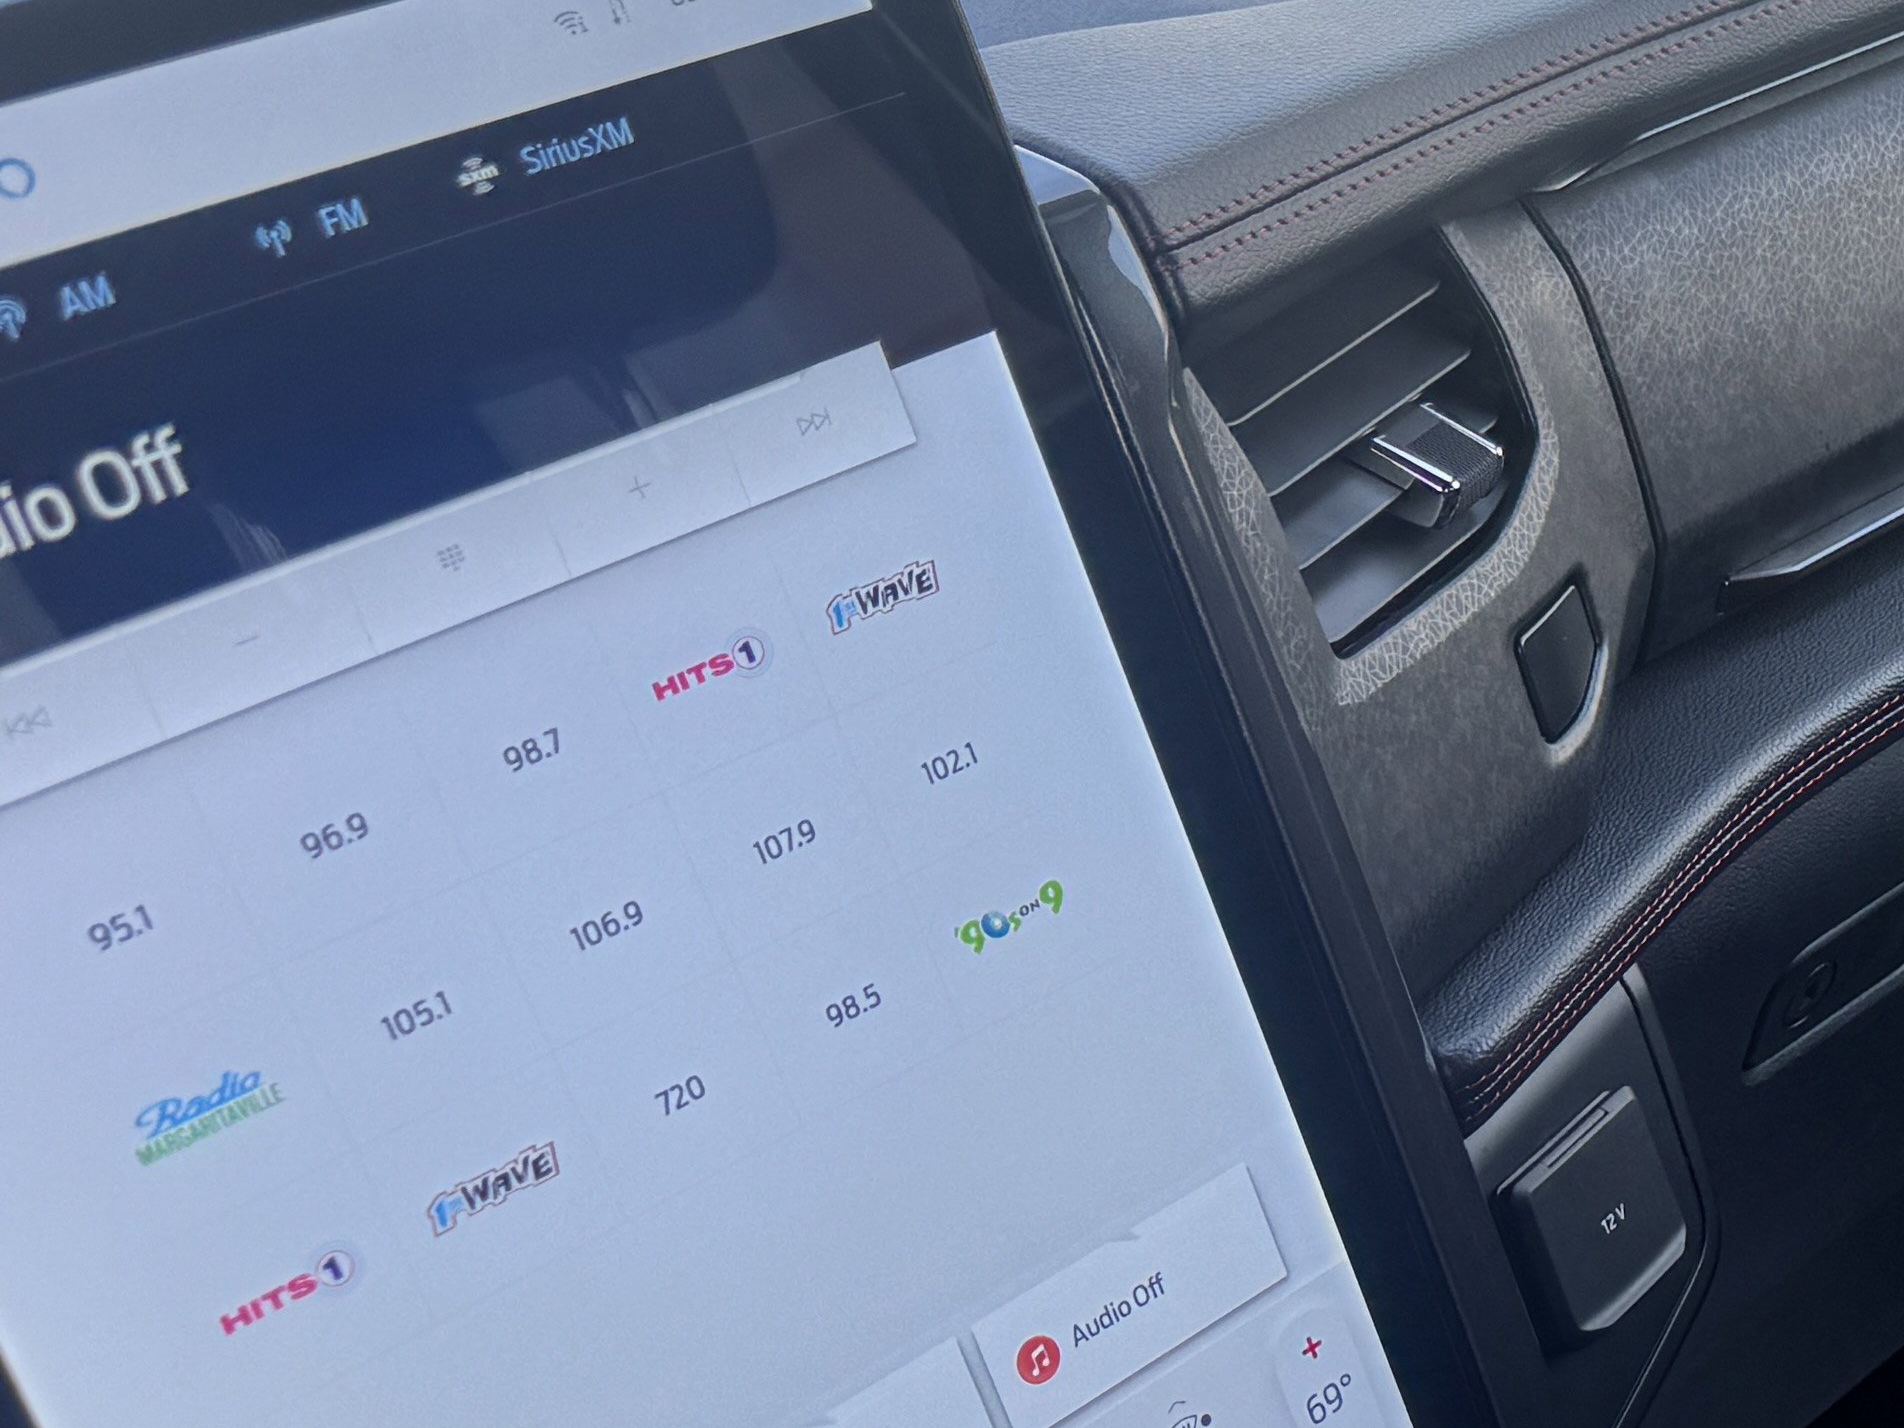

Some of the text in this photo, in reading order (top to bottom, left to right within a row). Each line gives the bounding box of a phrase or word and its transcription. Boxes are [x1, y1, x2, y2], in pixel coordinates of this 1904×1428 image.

[519, 117, 635, 176] SiriusXM
[318, 197, 369, 238] FM
[58, 272, 116, 321] AM
[77, 422, 190, 520] Off
[854, 568, 935, 615] WAVE
[502, 726, 562, 772] 98.7
[921, 741, 979, 786] 102.1
[300, 811, 370, 860] 96.9
[753, 818, 817, 865] 107.9
[87, 904, 155, 952] 95.1
[569, 900, 645, 952] 106.9
[381, 990, 453, 1041] 105.1
[825, 983, 881, 1028] 98.5
[134, 1070, 262, 1140] Radio
[656, 1074, 707, 1117] 720
[461, 1151, 553, 1211] WAVE
[1071, 1272, 1167, 1349] Audio Off
[1306, 1372, 1354, 1426] 69°
